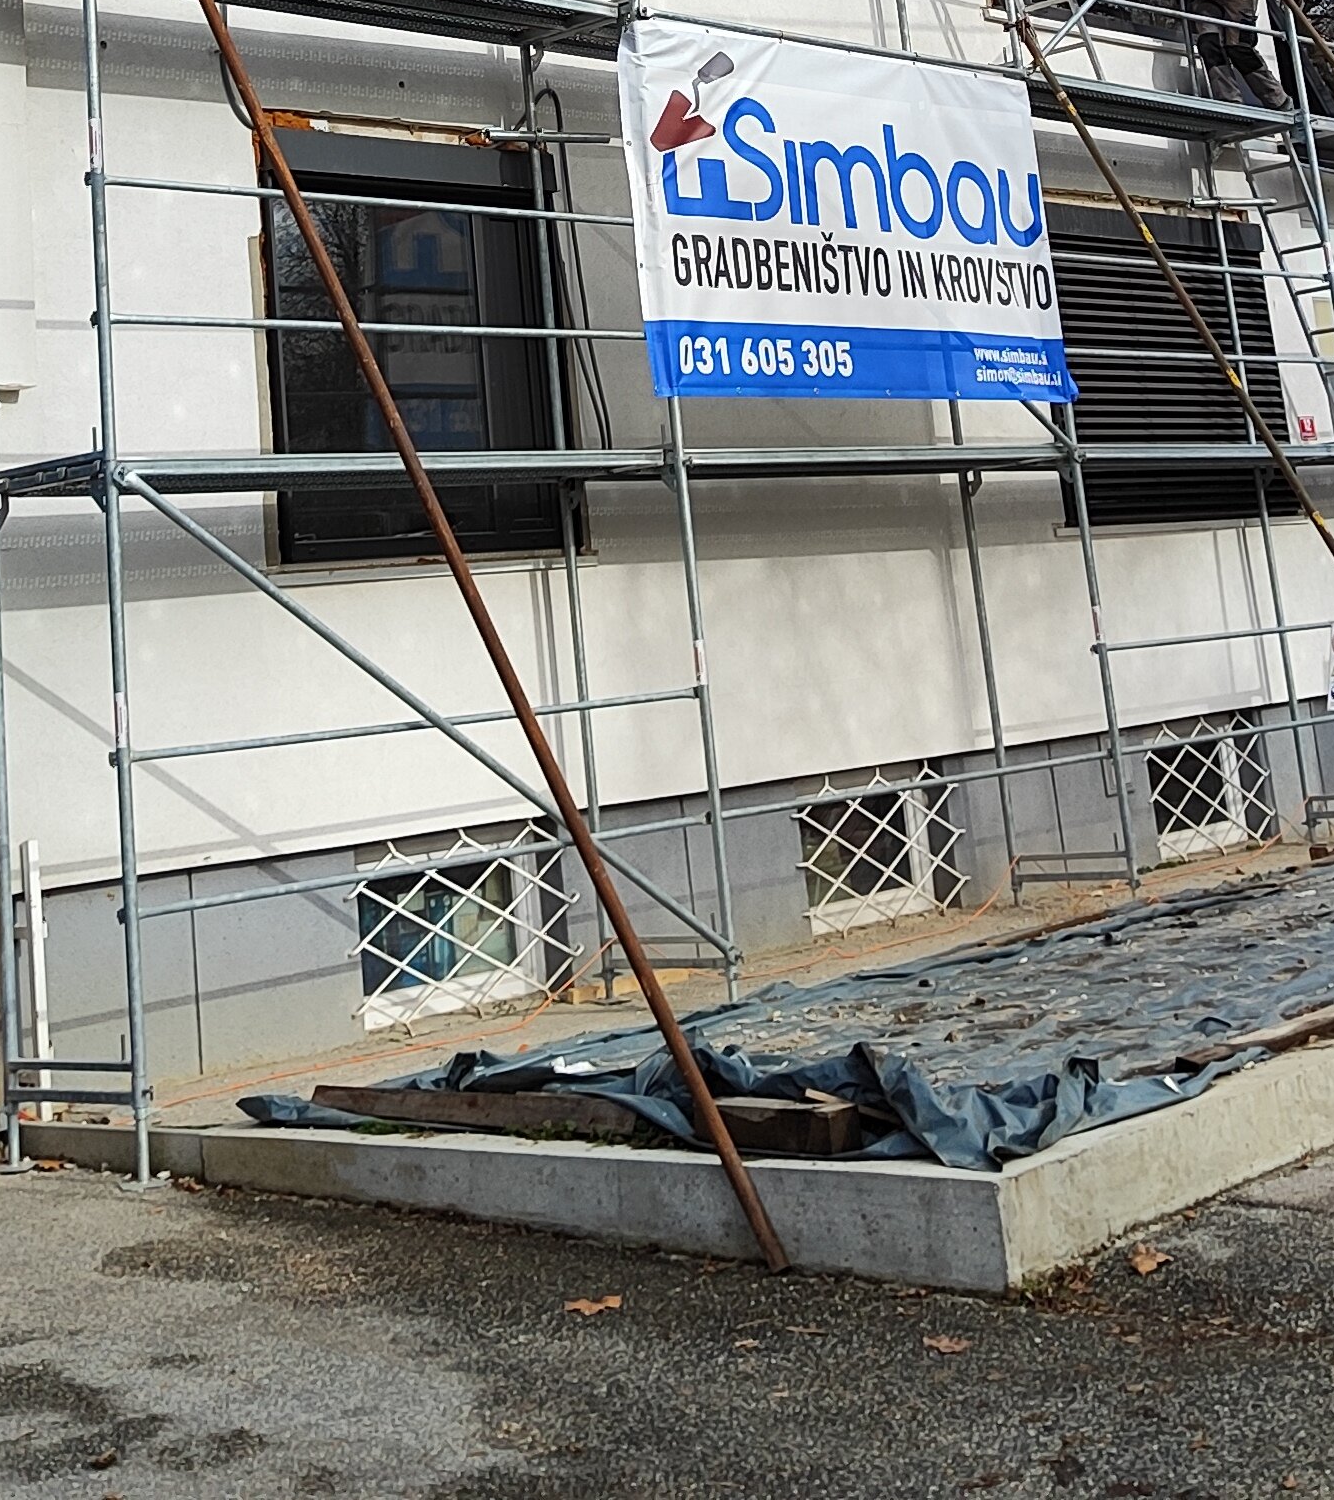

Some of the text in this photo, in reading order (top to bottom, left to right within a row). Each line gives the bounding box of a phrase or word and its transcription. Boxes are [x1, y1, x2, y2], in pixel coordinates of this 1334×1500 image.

[723, 96, 1043, 248] Simbau
[671, 231, 1053, 311] GRADBENIŠTVO IN KROVSTVO
[679, 336, 854, 377] 031 605 305
